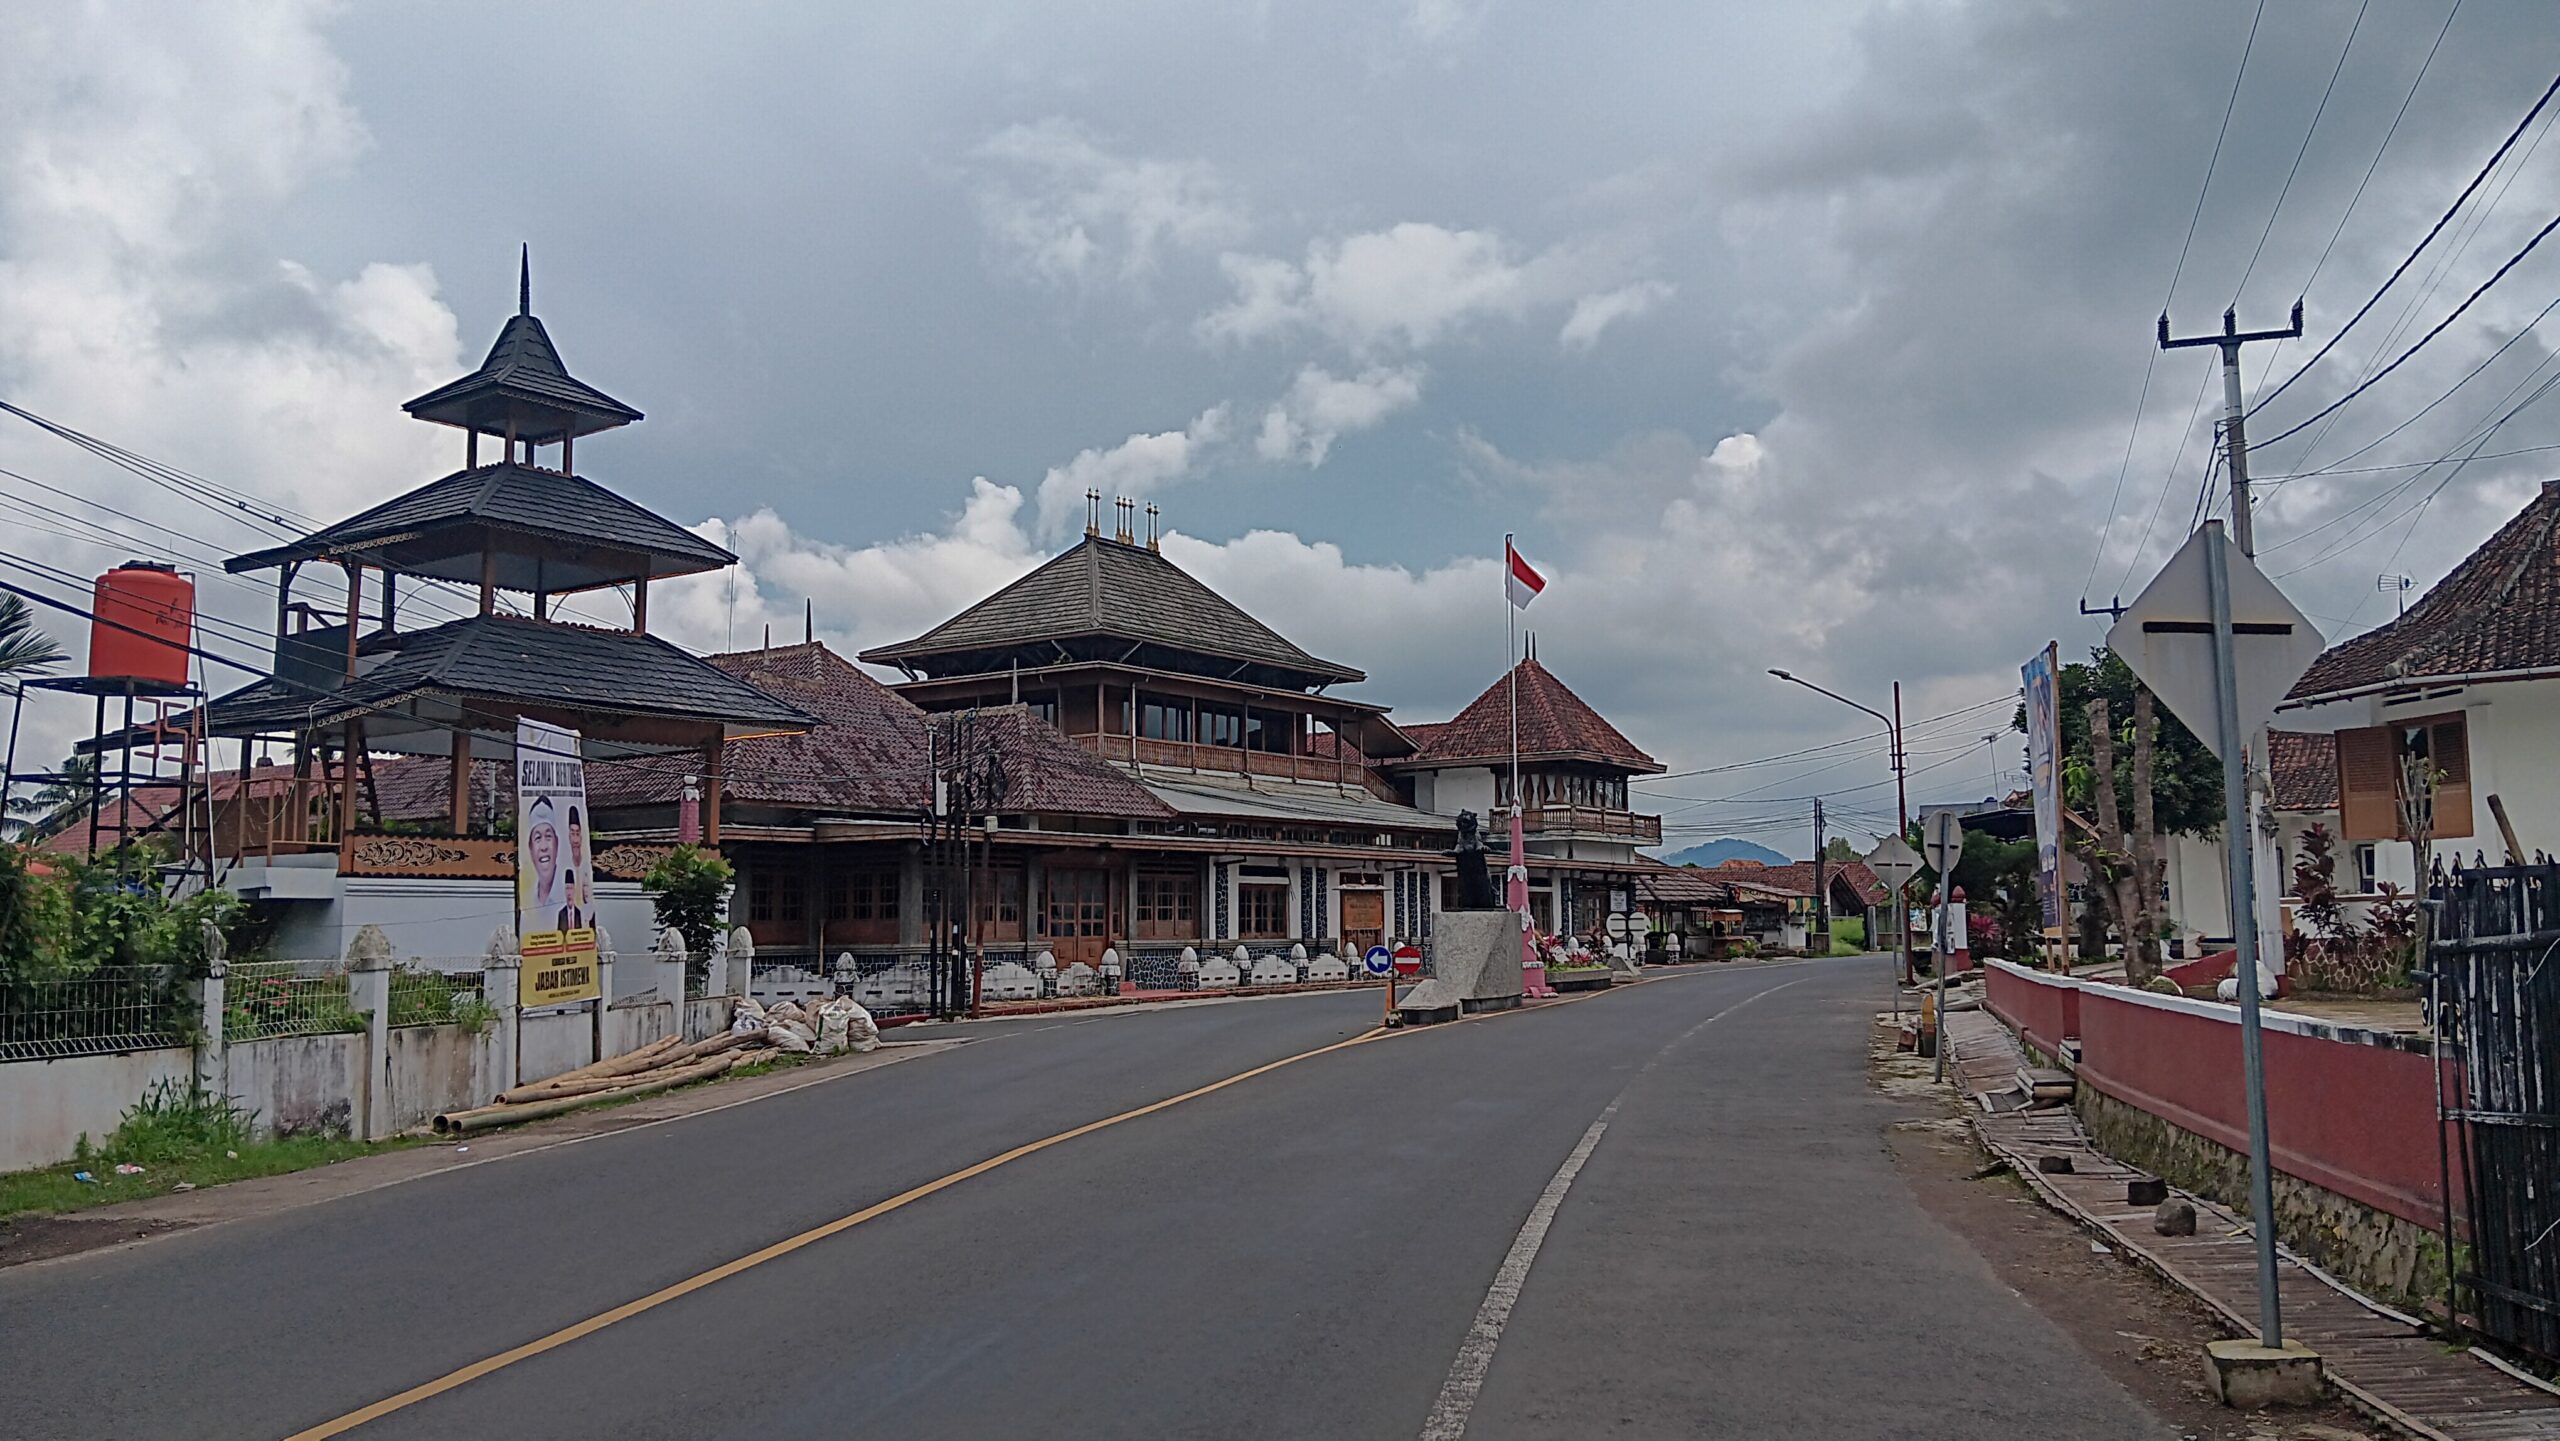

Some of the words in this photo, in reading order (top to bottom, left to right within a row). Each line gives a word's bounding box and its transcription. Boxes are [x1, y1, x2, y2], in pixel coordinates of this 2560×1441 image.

[521, 760, 554, 786] SELAMAT
[535, 969, 559, 992] JABAR
[560, 966, 590, 988] ISTIMEWA
